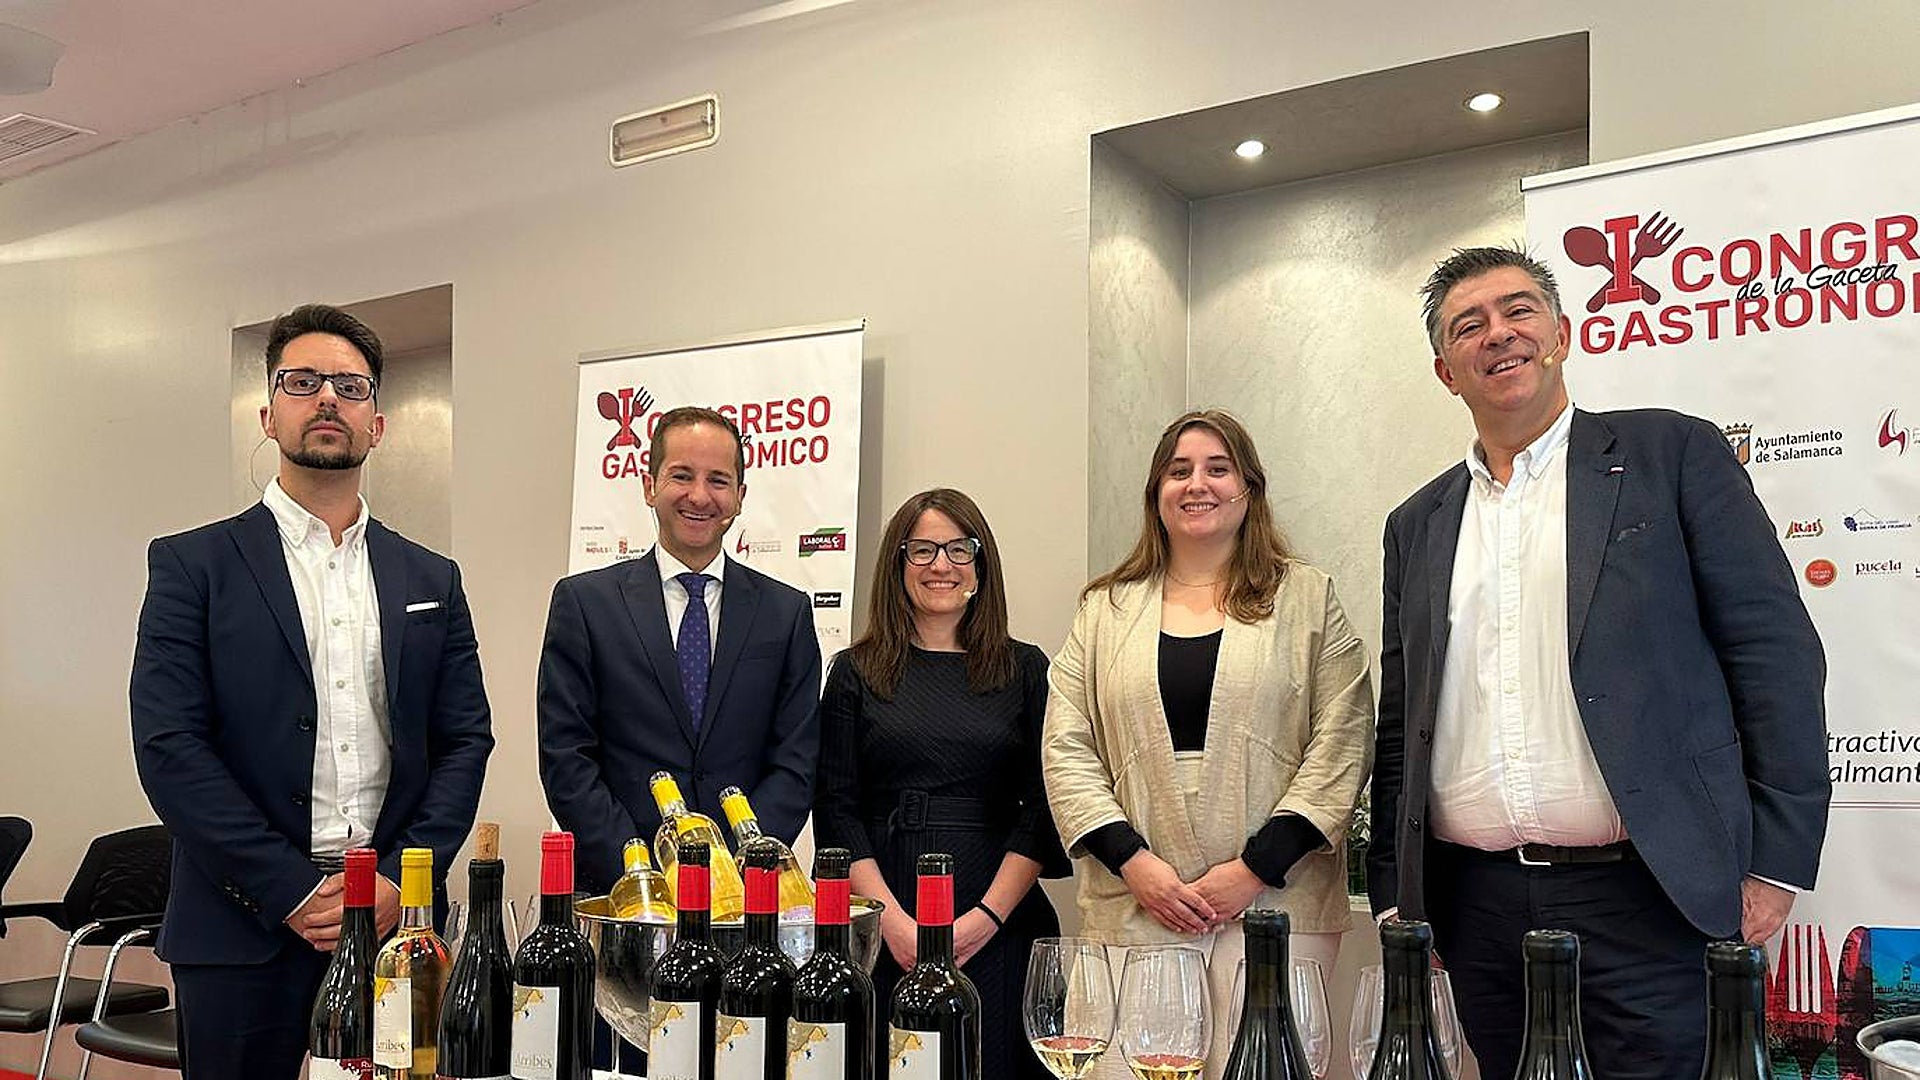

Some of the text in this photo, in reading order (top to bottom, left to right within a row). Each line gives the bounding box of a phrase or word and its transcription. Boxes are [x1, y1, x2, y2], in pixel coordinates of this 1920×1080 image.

[1671, 213, 1920, 293] CONGR
[1736, 257, 1899, 301] de la Gaceta
[1754, 429, 1843, 451] Ayuntamiento
[1755, 446, 1843, 464] de Salamanca
[1855, 560, 1902, 575] pucela
